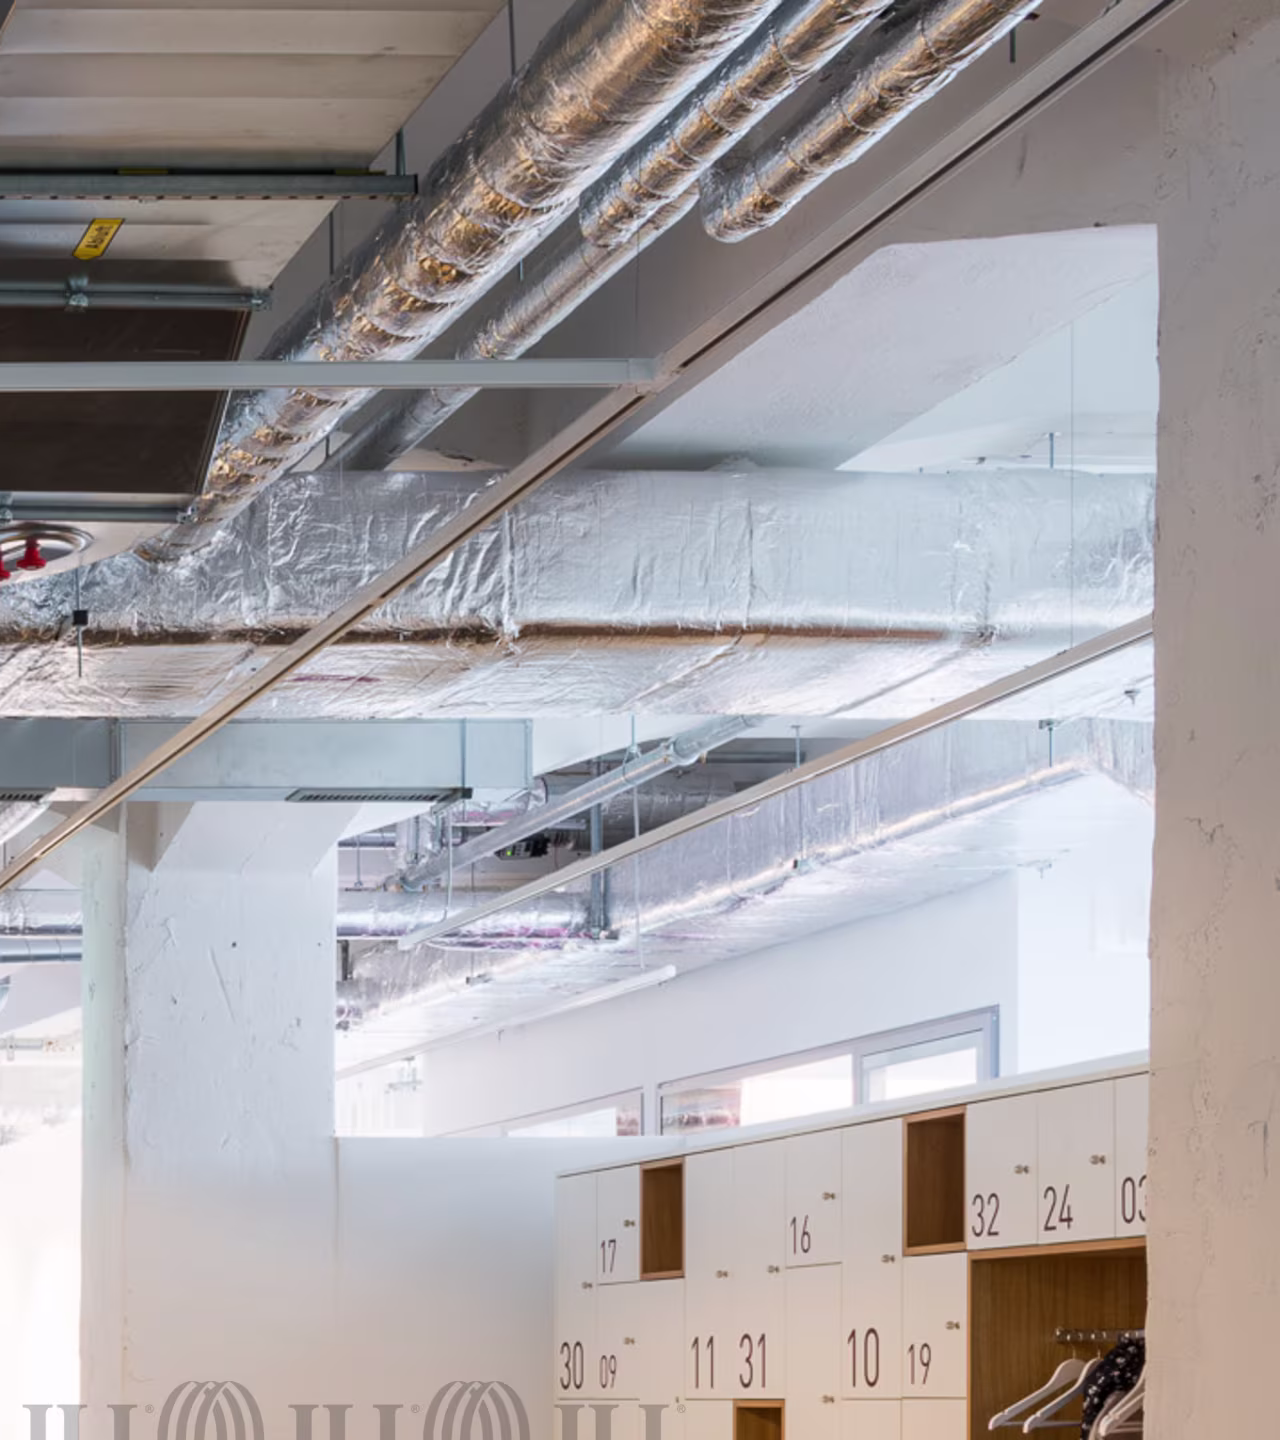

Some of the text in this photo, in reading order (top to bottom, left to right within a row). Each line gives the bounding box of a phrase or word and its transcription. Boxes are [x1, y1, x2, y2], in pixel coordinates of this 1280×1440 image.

[971, 1192, 1000, 1238] 32
[1043, 1184, 1074, 1232] 24
[600, 1238, 617, 1273] 17
[790, 1215, 811, 1254] 16
[560, 1341, 584, 1391] 30
[600, 1354, 617, 1389] 09
[691, 1335, 714, 1389] 11
[739, 1333, 766, 1389] 31
[847, 1327, 880, 1388] 10
[908, 1342, 932, 1385] 19
